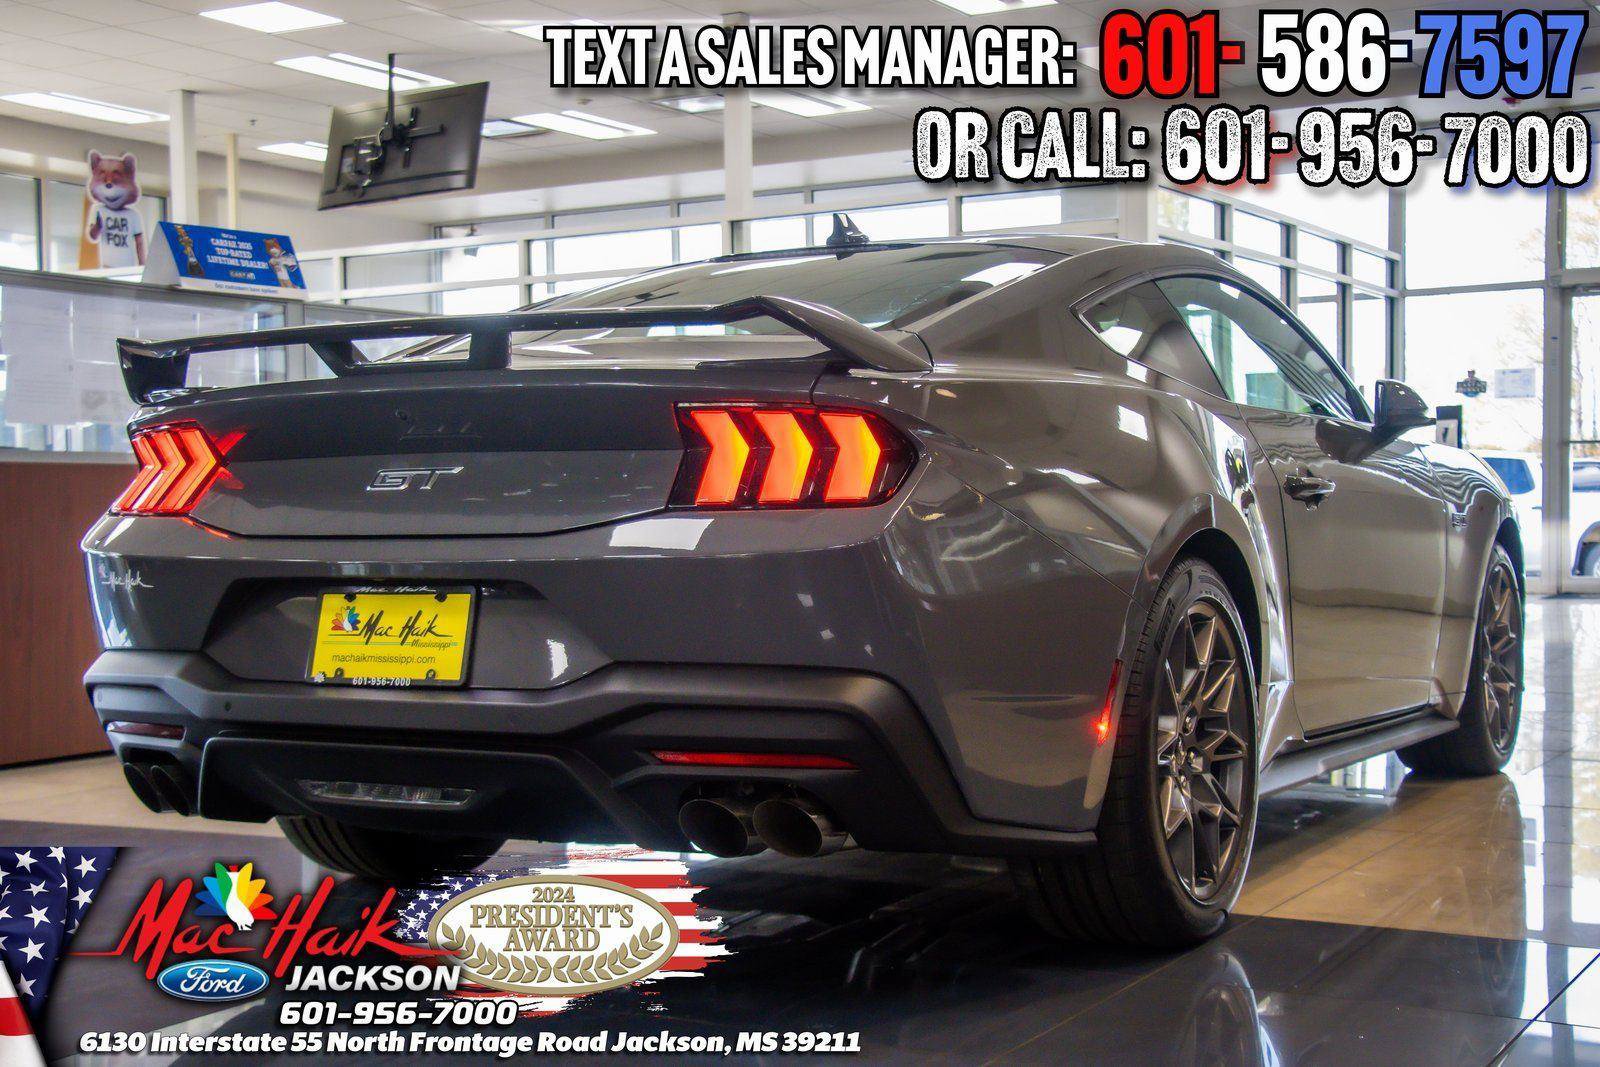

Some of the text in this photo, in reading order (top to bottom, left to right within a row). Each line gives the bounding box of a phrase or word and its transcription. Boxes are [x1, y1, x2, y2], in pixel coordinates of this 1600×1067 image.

[106, 216, 128, 231] CAR
[106, 232, 128, 247] FOX
[366, 466, 464, 490] GT
[340, 609, 447, 646] Mac Haik
[410, 640, 452, 650] Mississippi
[332, 653, 436, 666] machaikmississippi.com
[352, 677, 411, 687] 601-956-7000
